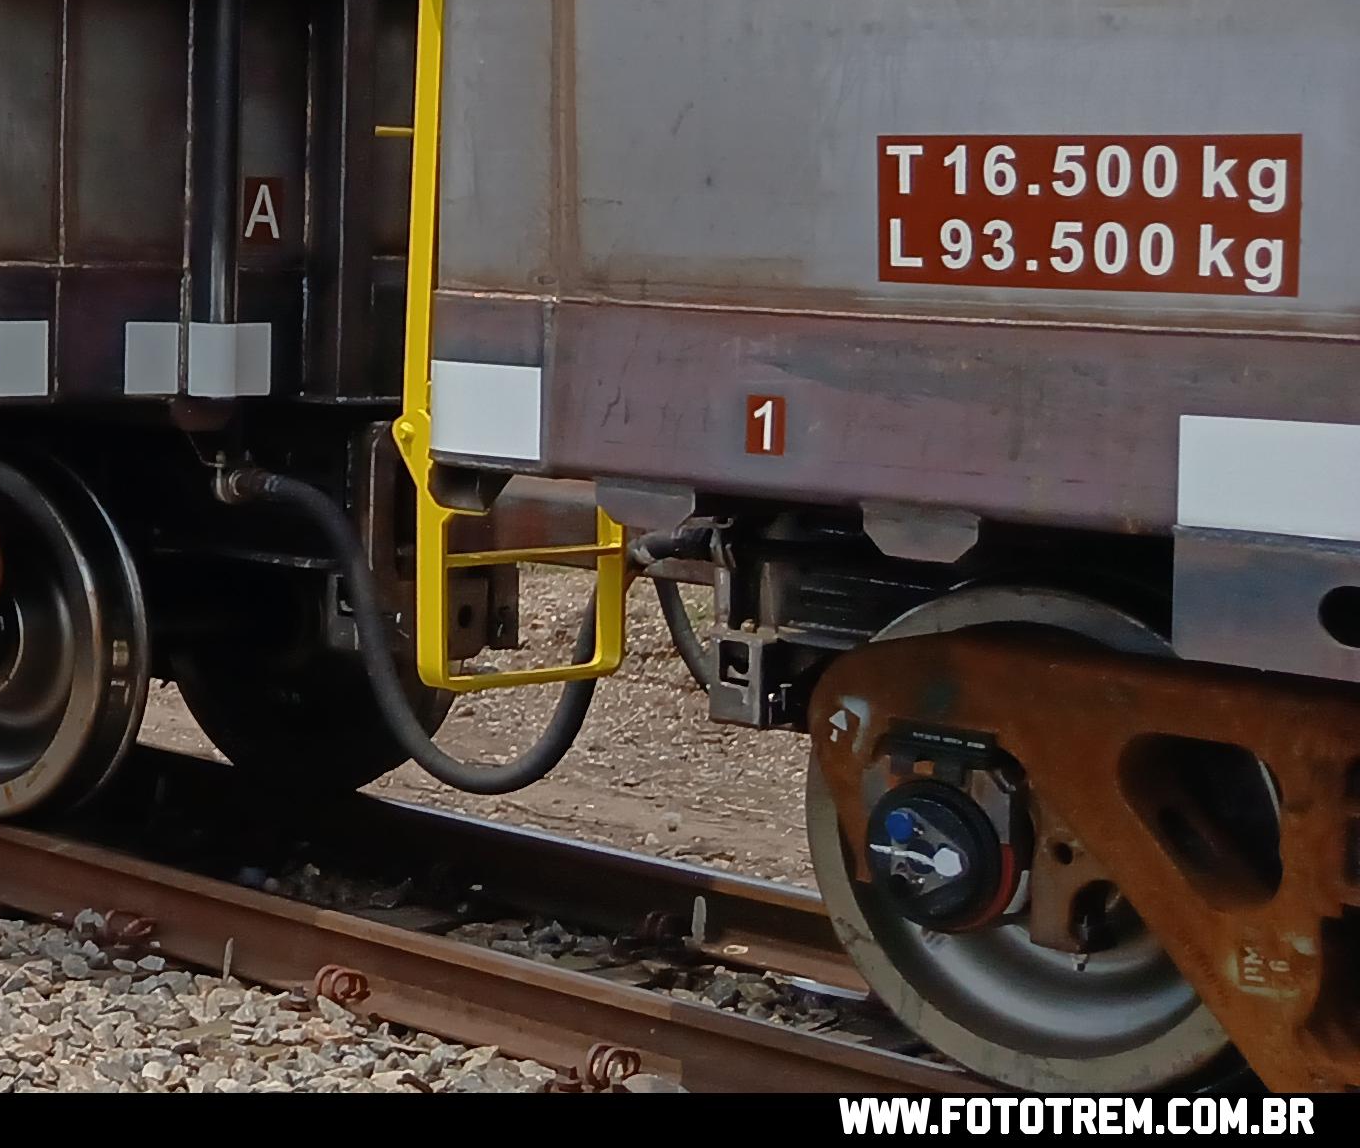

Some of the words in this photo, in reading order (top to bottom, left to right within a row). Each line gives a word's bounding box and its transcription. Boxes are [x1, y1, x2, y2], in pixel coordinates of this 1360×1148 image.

[886, 145, 924, 196] T
[943, 145, 1178, 199] 16.500
[1203, 146, 1288, 214] kg
[244, 184, 281, 239] A
[890, 218, 924, 268] L
[939, 219, 1175, 276] 93.500
[1199, 224, 1284, 294] kg
[753, 400, 774, 452] 1
